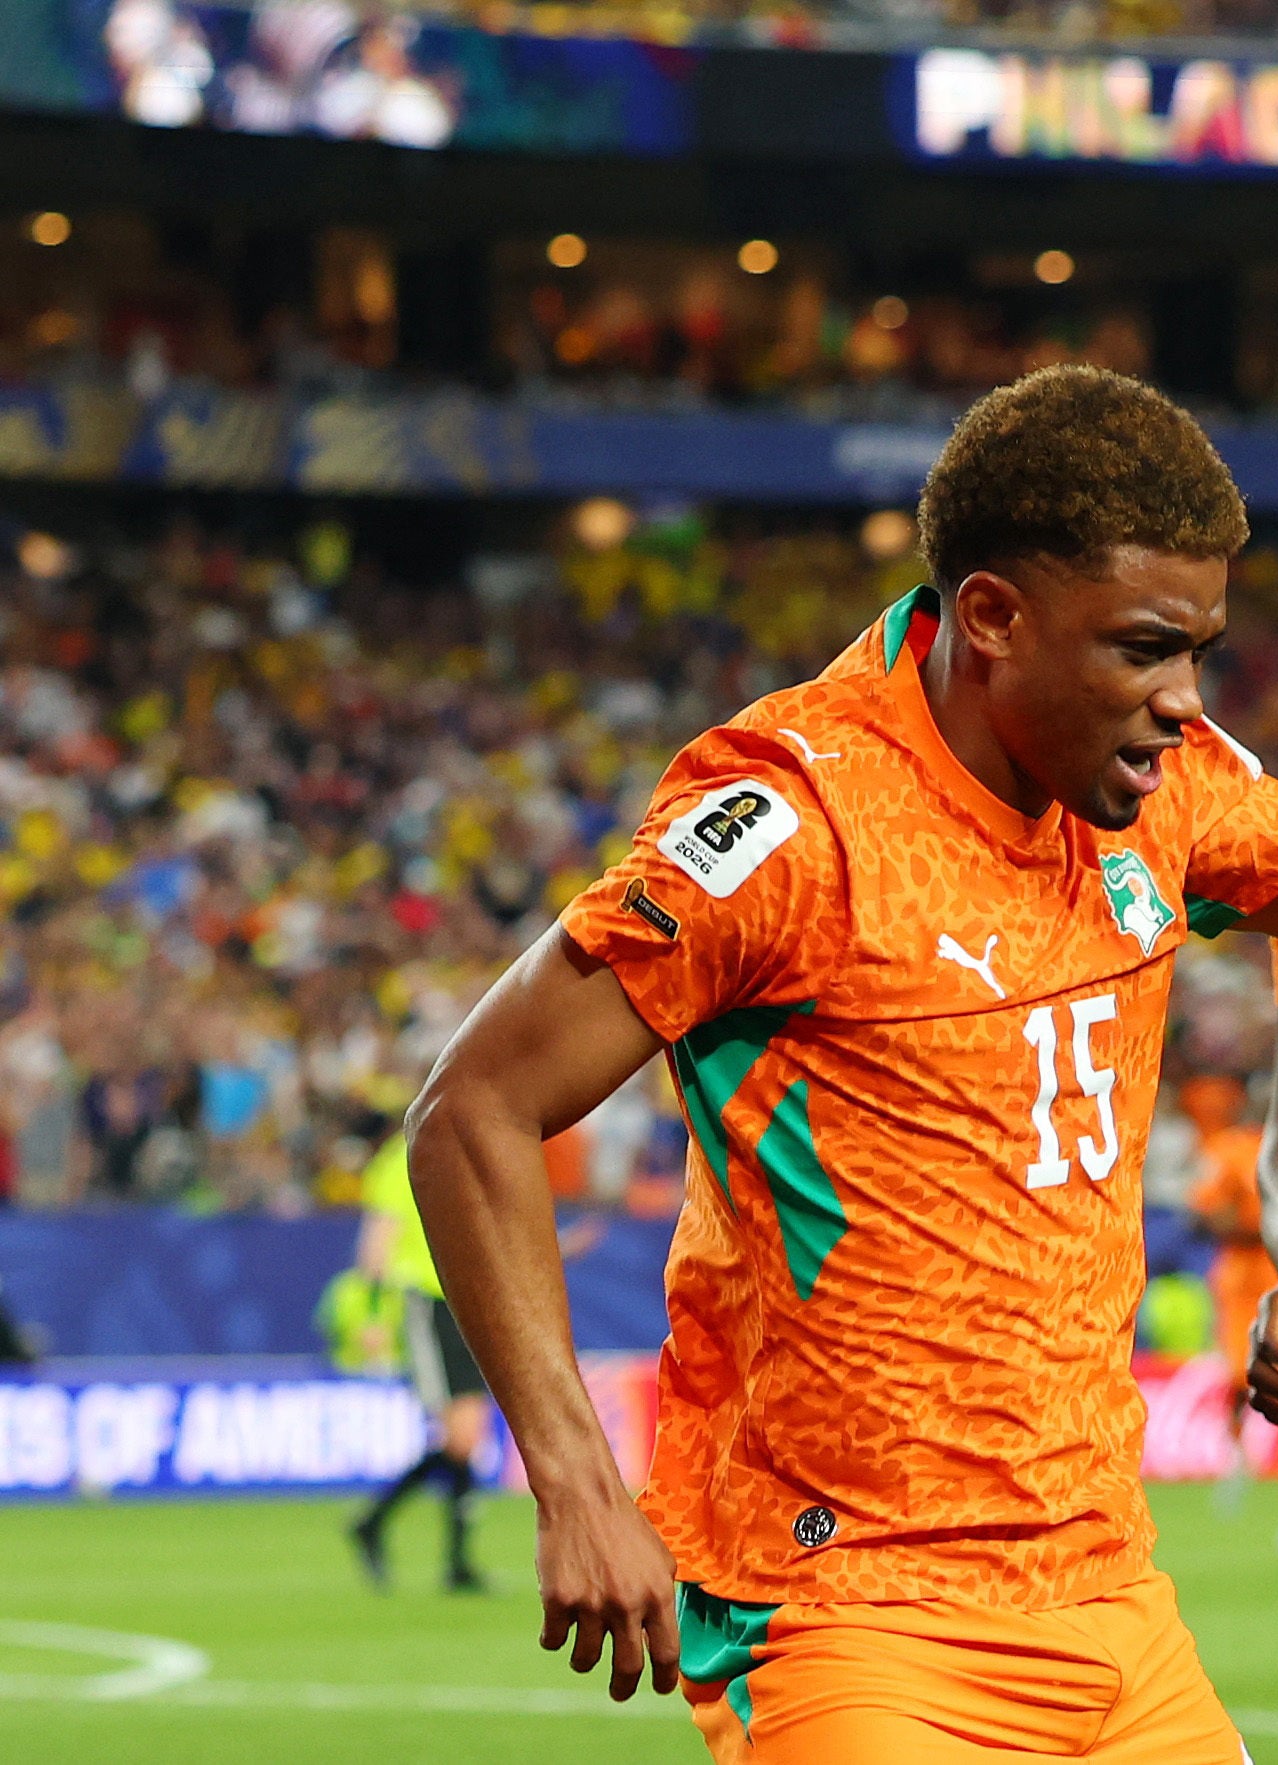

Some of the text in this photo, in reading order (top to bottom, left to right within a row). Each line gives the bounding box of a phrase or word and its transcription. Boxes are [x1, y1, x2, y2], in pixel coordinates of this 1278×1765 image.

[702, 826, 723, 847] FIFA
[674, 841, 713, 876] 2026
[637, 896, 675, 929] DEBUT
[1022, 993, 1118, 1190] 15
